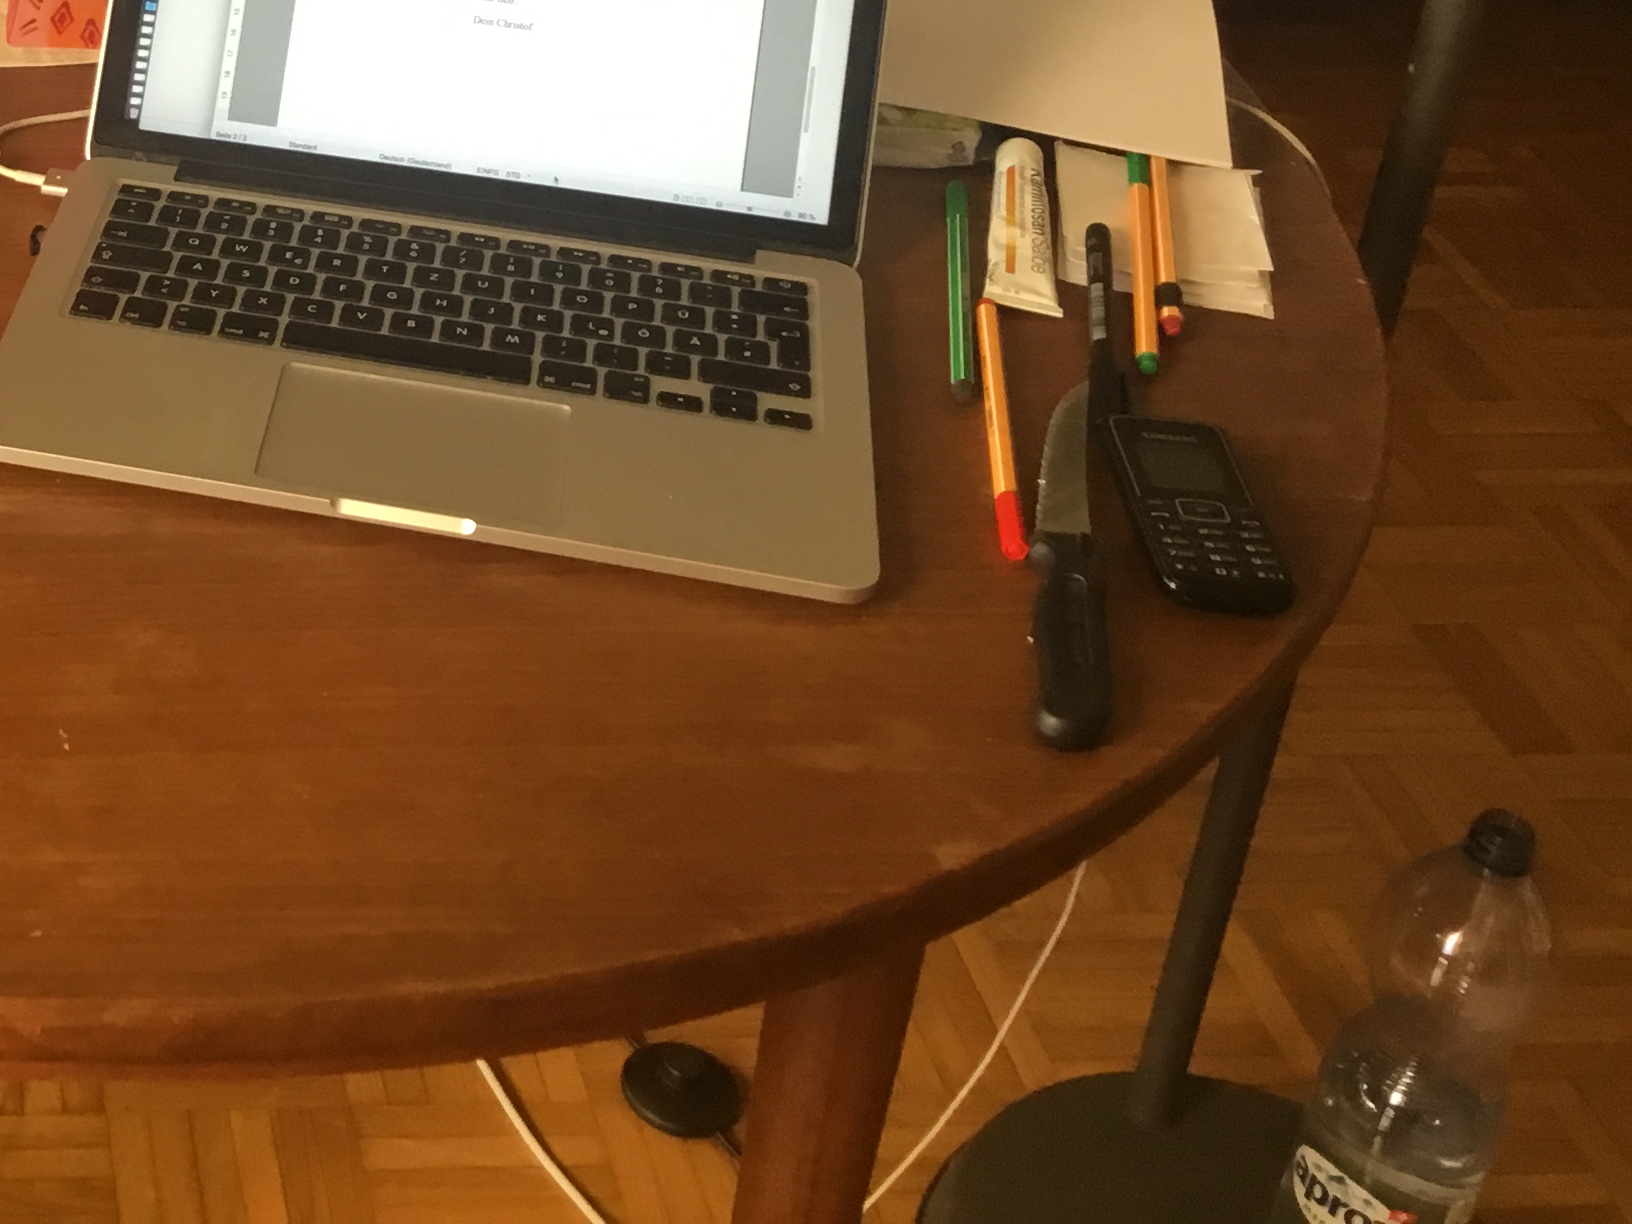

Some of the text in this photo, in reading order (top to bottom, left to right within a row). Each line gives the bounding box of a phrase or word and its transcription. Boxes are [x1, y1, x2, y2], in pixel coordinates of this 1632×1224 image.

[473, 16, 534, 31] Dein Christof
[1294, 1155, 1386, 1224] apro
